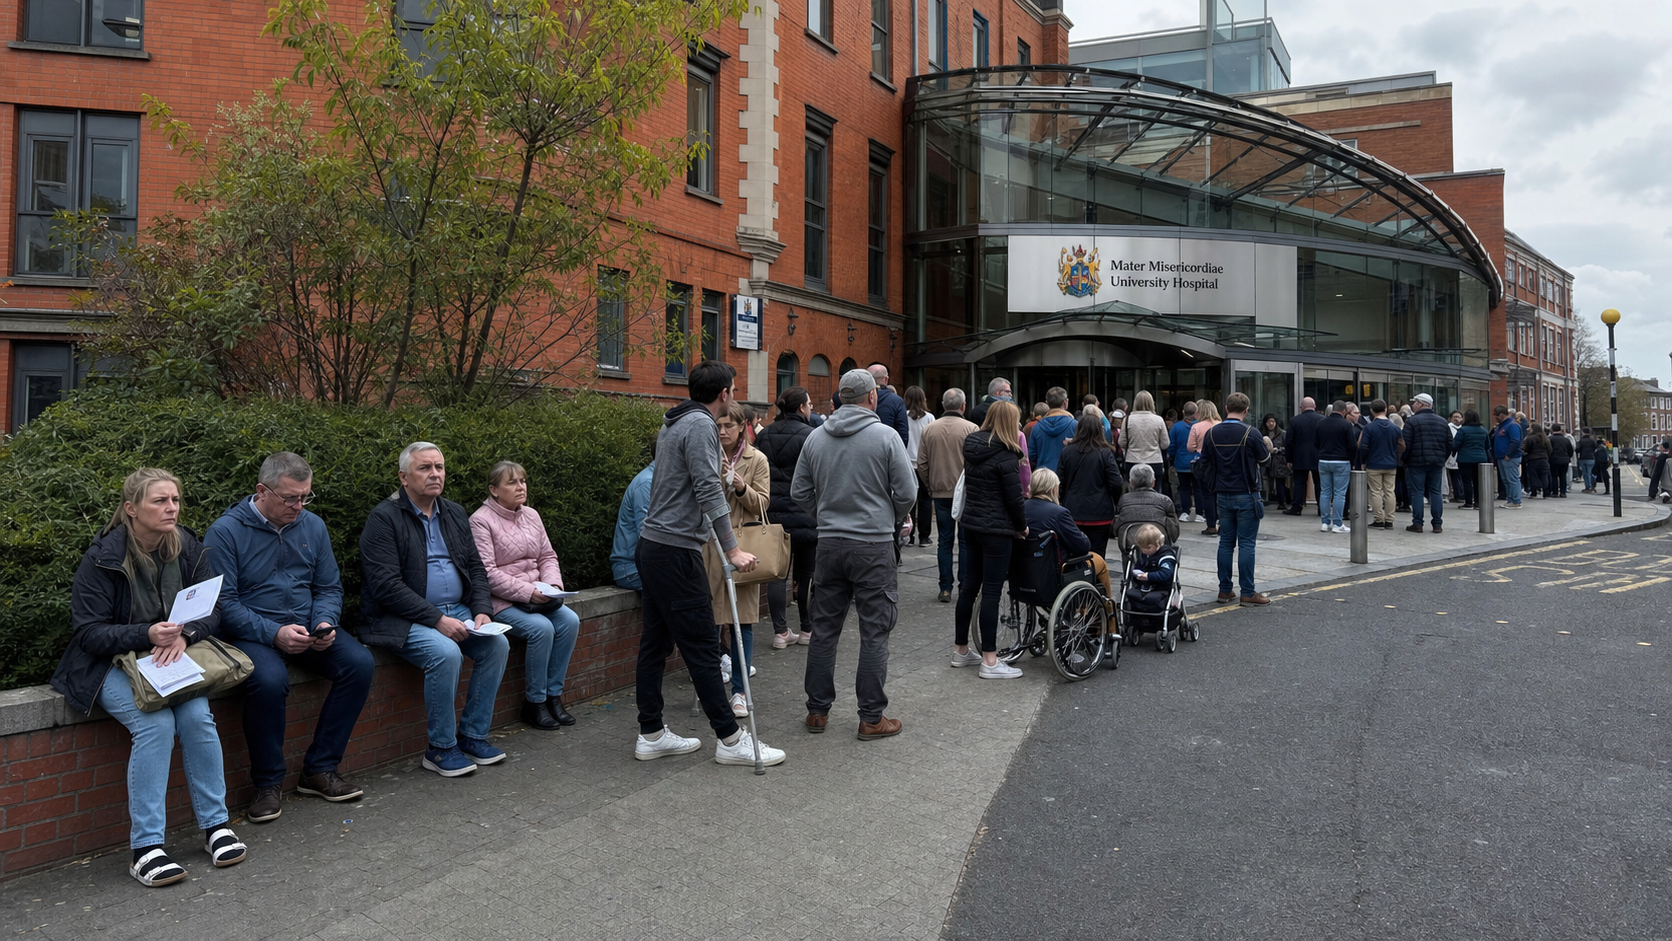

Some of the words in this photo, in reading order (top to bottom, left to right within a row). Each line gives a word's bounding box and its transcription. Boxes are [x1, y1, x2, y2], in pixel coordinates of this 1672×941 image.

[1110, 260, 1146, 271] Mater
[1149, 261, 1224, 274] Misericordiae
[1111, 276, 1170, 291] University
[1173, 277, 1218, 291] Hospital
